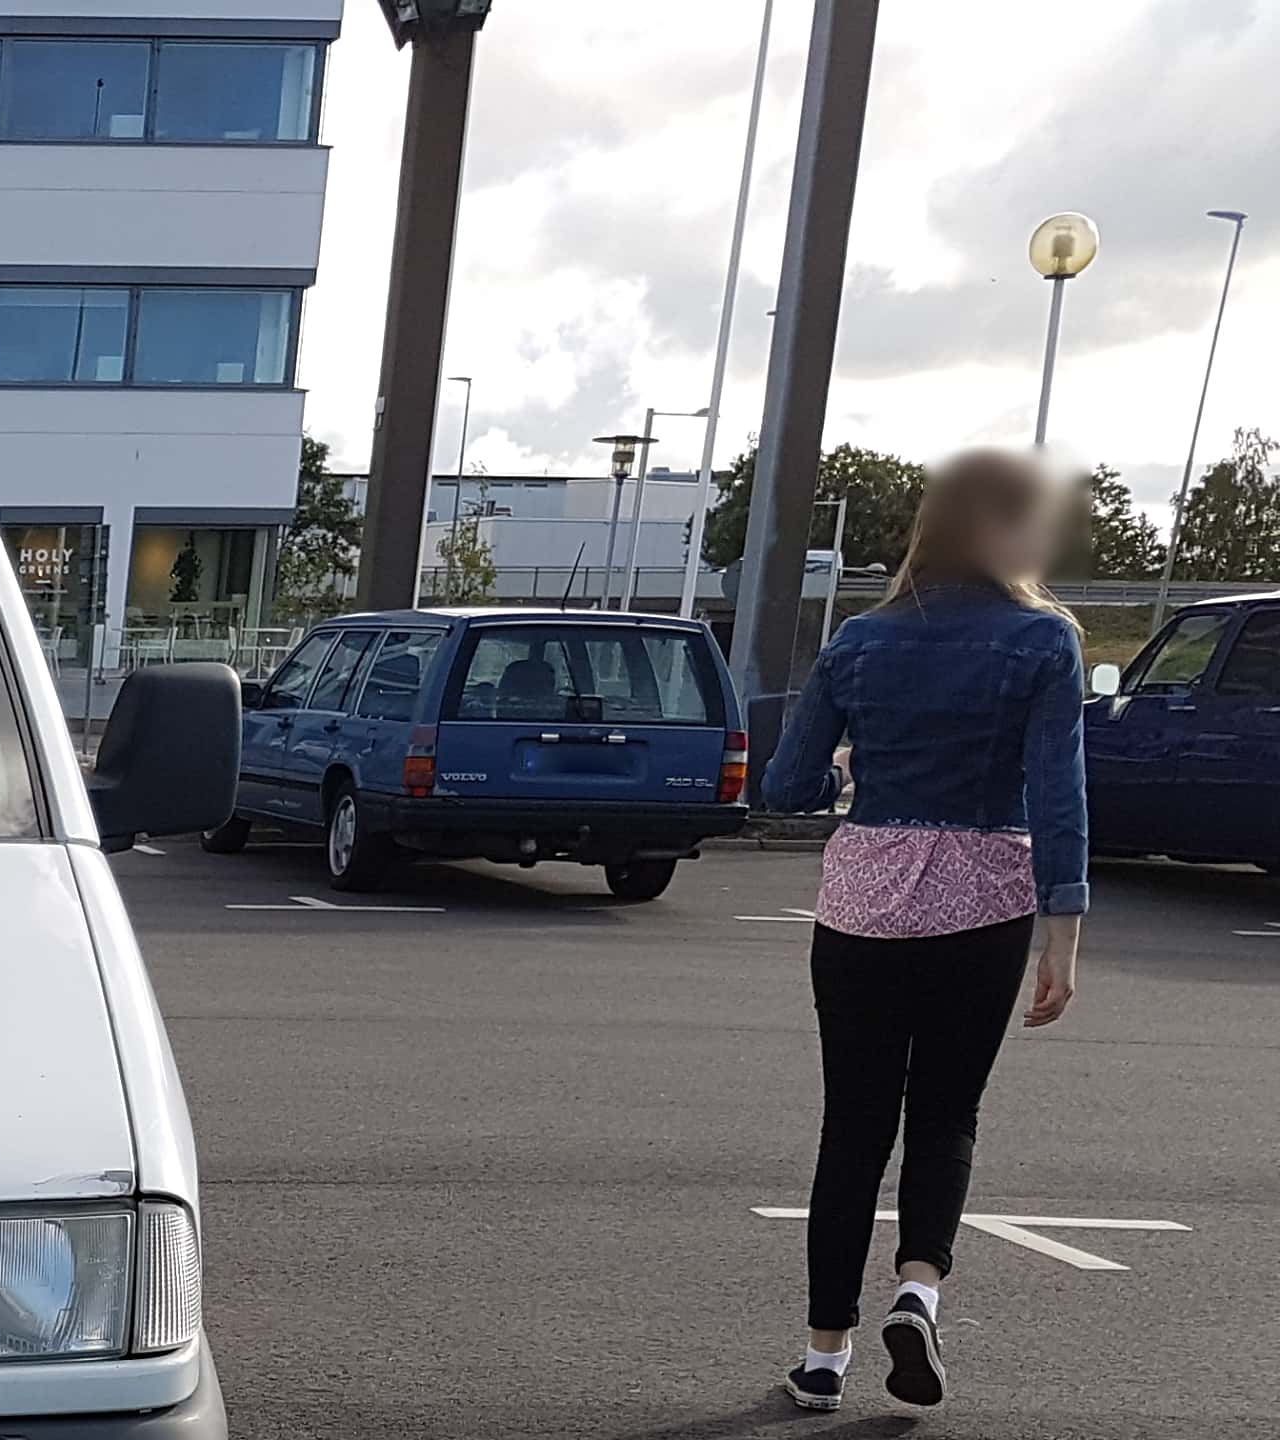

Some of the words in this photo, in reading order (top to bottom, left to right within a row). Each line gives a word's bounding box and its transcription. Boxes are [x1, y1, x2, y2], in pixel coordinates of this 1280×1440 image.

[20, 548, 73, 562] HOLY
[19, 564, 70, 575] GREENS
[440, 772, 487, 781] VOLVO
